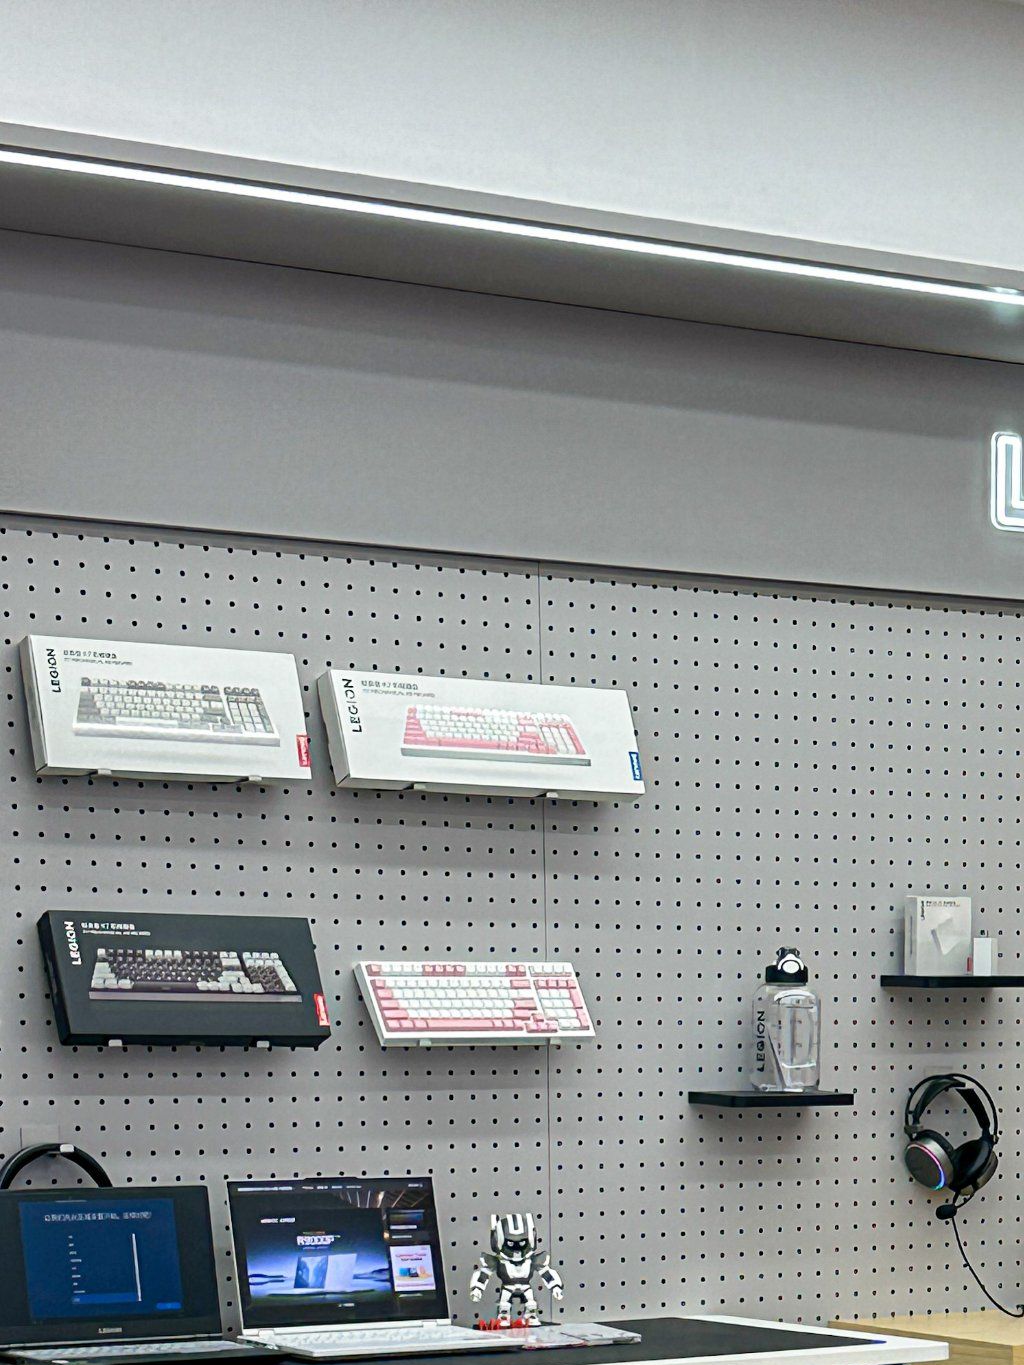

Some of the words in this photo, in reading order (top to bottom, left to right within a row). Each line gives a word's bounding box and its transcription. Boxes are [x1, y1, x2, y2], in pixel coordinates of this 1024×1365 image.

[46, 648, 62, 693] LEGION
[342, 678, 363, 733] LEGION
[64, 920, 82, 966] LEGION
[756, 1010, 766, 1072] LEGION
